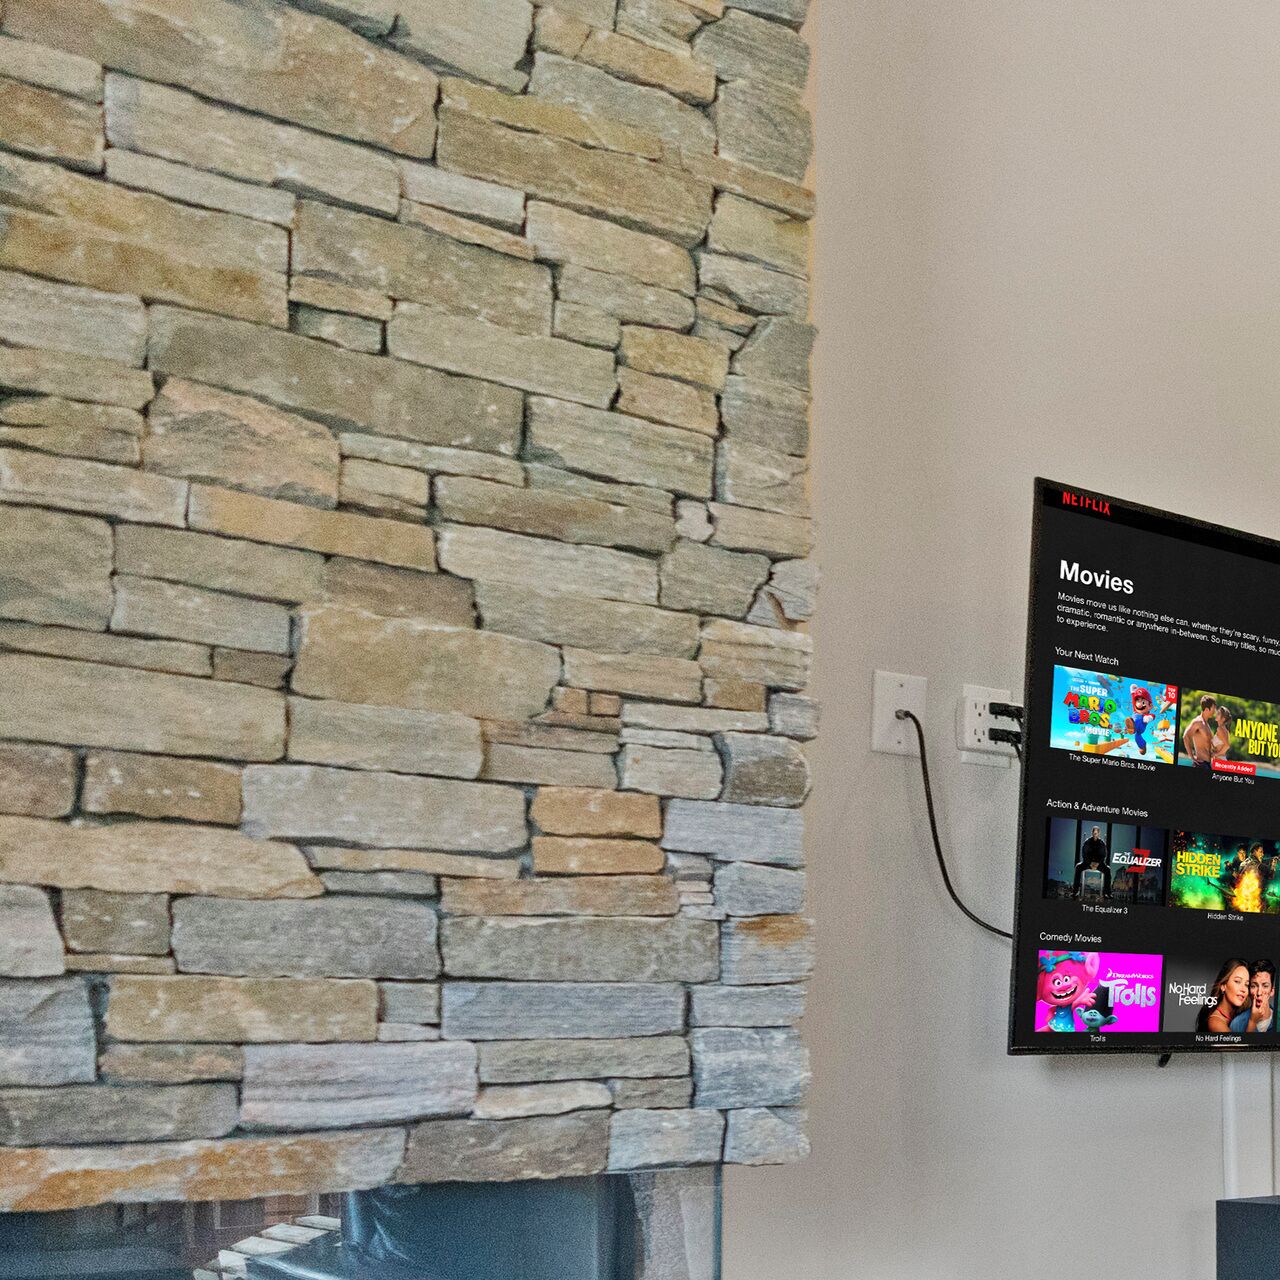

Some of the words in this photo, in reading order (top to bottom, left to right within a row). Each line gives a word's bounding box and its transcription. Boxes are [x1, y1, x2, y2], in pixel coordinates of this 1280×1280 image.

[1059, 559, 1134, 595] Movies
[1057, 591, 1085, 605] Movies
[1086, 598, 1107, 610] move
[1108, 604, 1117, 612] us
[1118, 604, 1131, 615] like
[1132, 608, 1159, 622] nothing
[1160, 614, 1175, 624] else
[1191, 621, 1219, 633] whether
[1219, 626, 1242, 638] they're
[1056, 614, 1065, 623] to
[1065, 616, 1109, 632] experience.
[1056, 603, 1092, 618] dramatic,
[1093, 611, 1126, 625] romantic
[1126, 618, 1136, 626] or
[1135, 619, 1169, 634] anywhere
[1170, 626, 1210, 642] in-between.
[1210, 634, 1221, 644] So
[1221, 638, 1240, 650] many
[1258, 646, 1267, 654] so
[1054, 646, 1073, 658] Your
[1074, 650, 1093, 661] Next
[1094, 653, 1120, 666] Watch
[1080, 684, 1108, 697] SUPER
[1063, 691, 1117, 714] MARIO
[1085, 726, 1110, 737] MOVIE
[1234, 718, 1279, 743] ANYONE
[1248, 739, 1266, 756] BUT
[1068, 753, 1081, 761] The
[1082, 754, 1101, 765] Super
[1101, 757, 1119, 767] Mario
[1137, 762, 1156, 772] Movie
[1214, 761, 1236, 771] Recently
[1236, 765, 1253, 773] Added
[1211, 773, 1233, 782] Anyone
[1233, 775, 1244, 783] But
[1244, 776, 1255, 785] You
[1046, 798, 1072, 810] Action
[1073, 801, 1080, 810] &
[1080, 802, 1120, 815] Adventure
[1121, 806, 1149, 818] Movies
[1112, 852, 1162, 867] EQUALIZER
[1176, 850, 1222, 866] HIDDEN
[1175, 863, 1221, 878] STRIKE
[1081, 904, 1094, 912] The
[1094, 905, 1122, 914] Equalizer
[1207, 912, 1227, 921] Hidden
[1228, 913, 1244, 922] Strike
[1039, 931, 1073, 944] Comedy
[1074, 933, 1102, 943] Movies
[1169, 982, 1183, 994] No
[1182, 983, 1207, 995] Hard
[1178, 993, 1218, 1008] Feelings
[1219, 1034, 1242, 1043] Feelings
